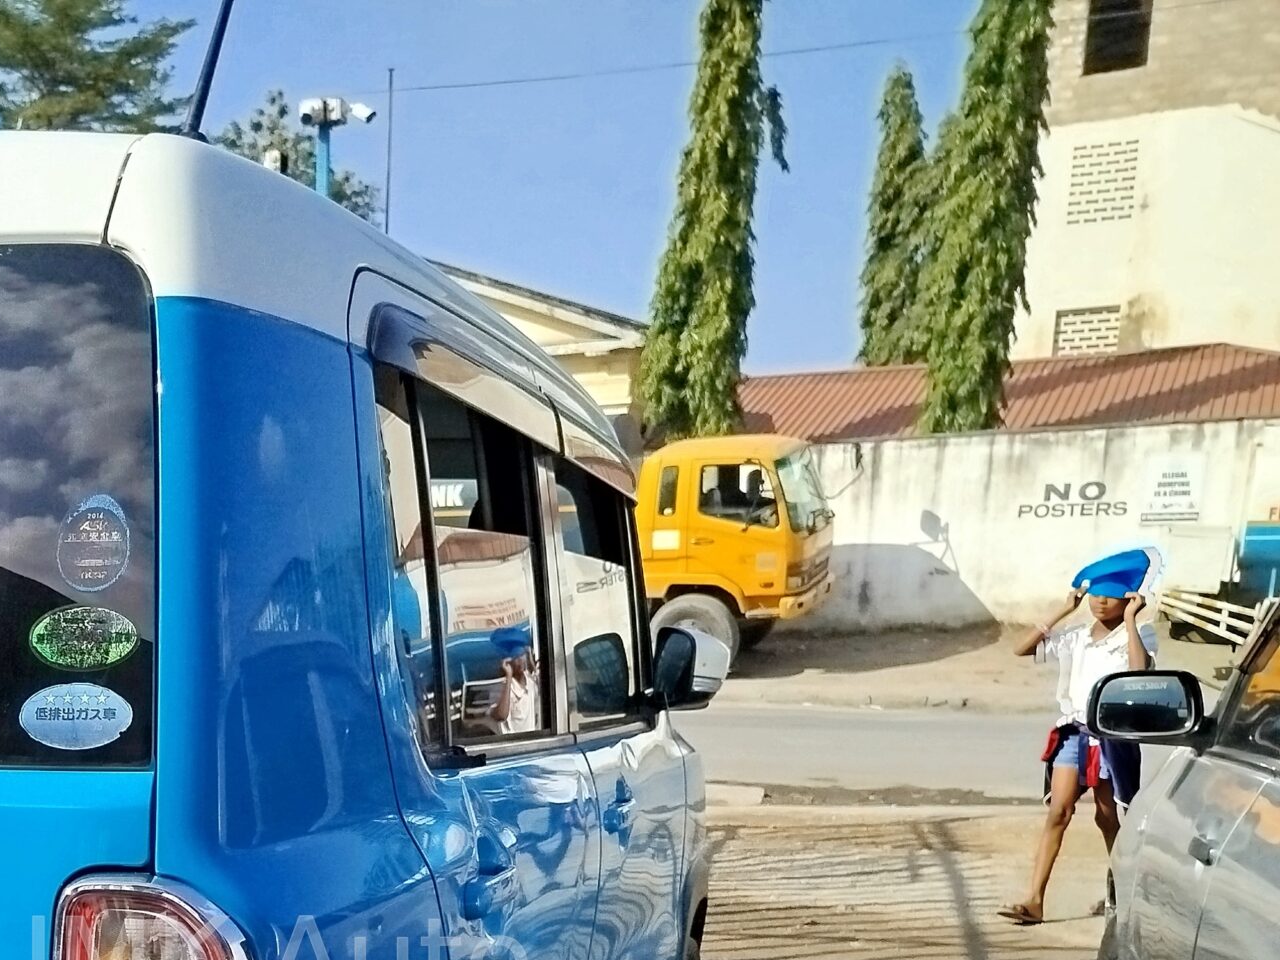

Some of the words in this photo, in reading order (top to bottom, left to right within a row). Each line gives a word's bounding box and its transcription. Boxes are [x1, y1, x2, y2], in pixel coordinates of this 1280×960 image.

[1043, 481, 1107, 501] NO
[1017, 501, 1128, 518] POSTERS
[35, 707, 117, 721] 低排出ガス車
